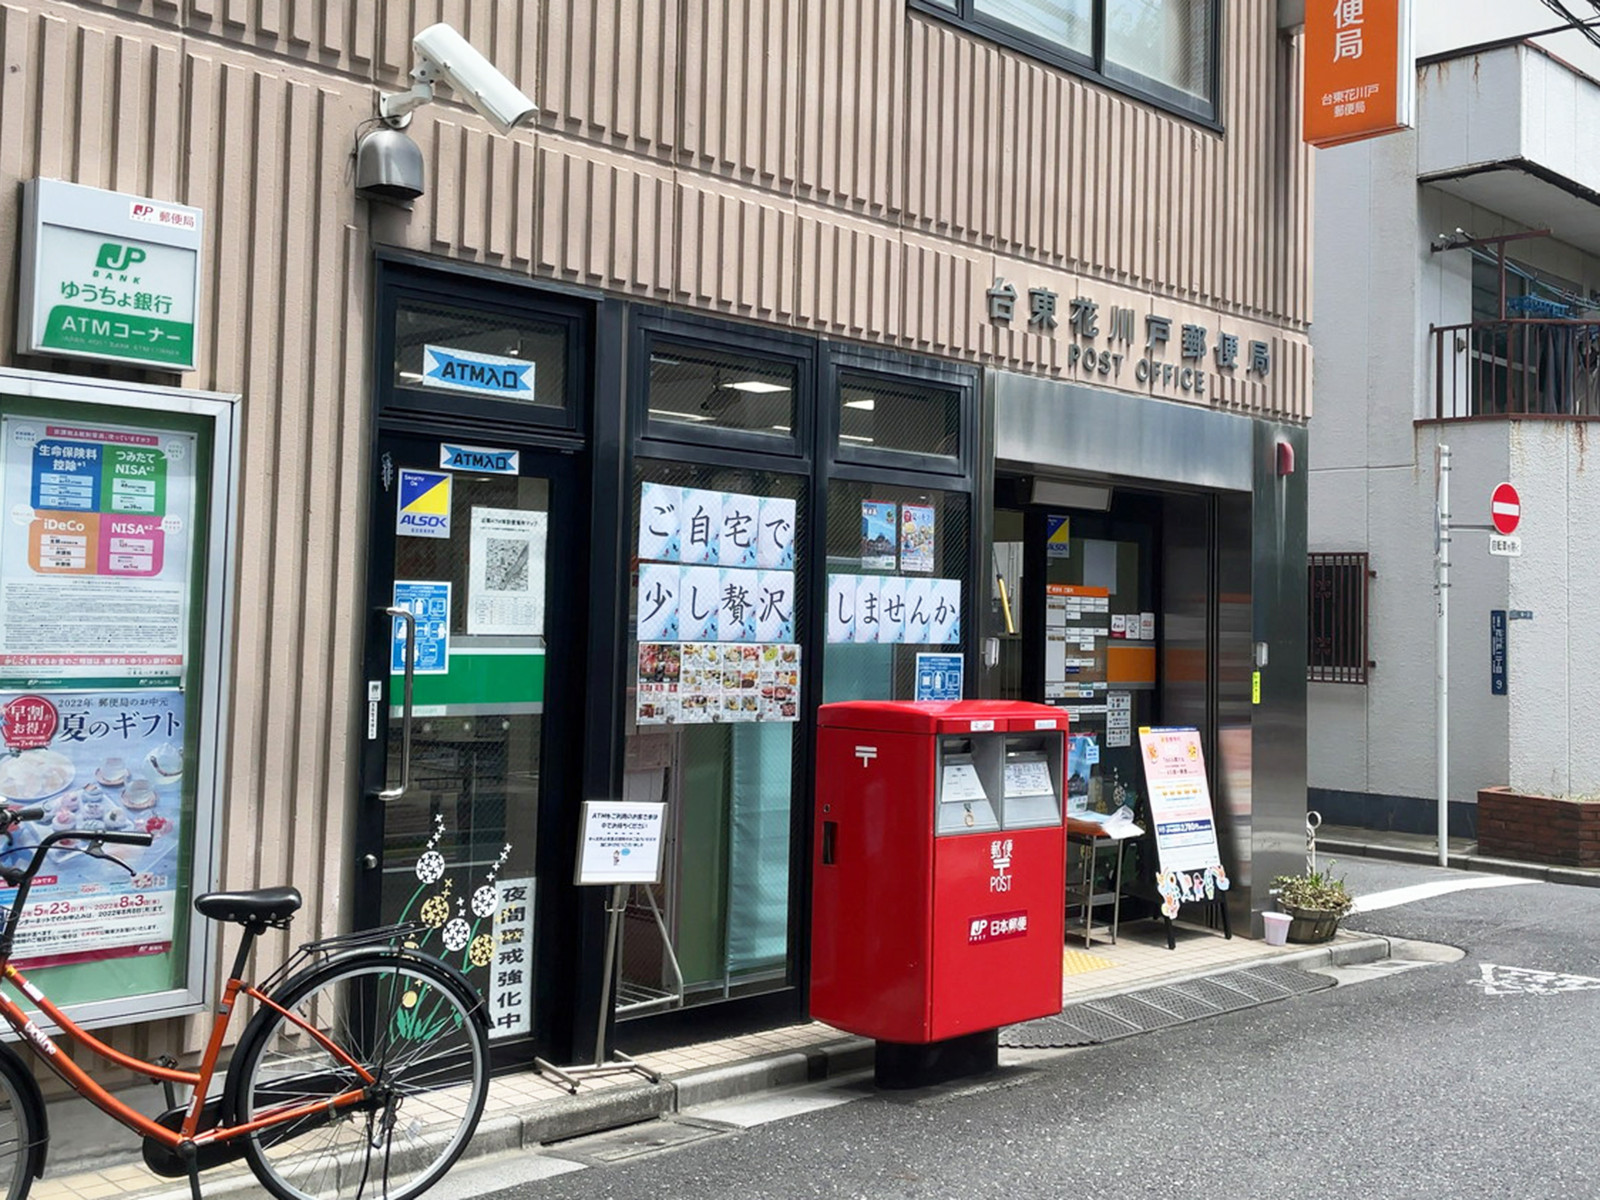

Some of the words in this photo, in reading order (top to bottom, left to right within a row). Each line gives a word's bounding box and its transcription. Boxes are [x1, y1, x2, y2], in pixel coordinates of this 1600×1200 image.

[1321, 83, 1379, 106] 台東花川戸
[1333, 101, 1366, 117] 郵便局
[159, 211, 195, 228] 郵便局
[92, 270, 141, 284] BANK
[61, 281, 173, 314] ゆうちょ銀行
[61, 315, 181, 343] ATMコーナー
[986, 277, 1270, 377] 台東花川戸郵便局
[442, 361, 518, 389] ATM入口
[1068, 343, 1124, 378] POST
[1136, 358, 1206, 394] OFFICE
[38, 444, 98, 460] 生命保険料
[115, 450, 156, 464] つみたて
[453, 453, 507, 471] ATM入口
[43, 518, 85, 532] iDeCo
[400, 514, 447, 528] ALSOK
[648, 503, 792, 549] ご自宅で
[641, 581, 791, 627] 少し贅沢
[837, 592, 957, 626] しませんか
[58, 698, 93, 708] 2022年
[99, 697, 169, 708] 郵便局のお中元
[60, 710, 180, 743] 夏のギフト
[990, 840, 1013, 859] 郵便
[990, 875, 1012, 892] POST
[990, 916, 1027, 936] 日本郵便
[497, 885, 528, 1029] 夜間警戒強化中
